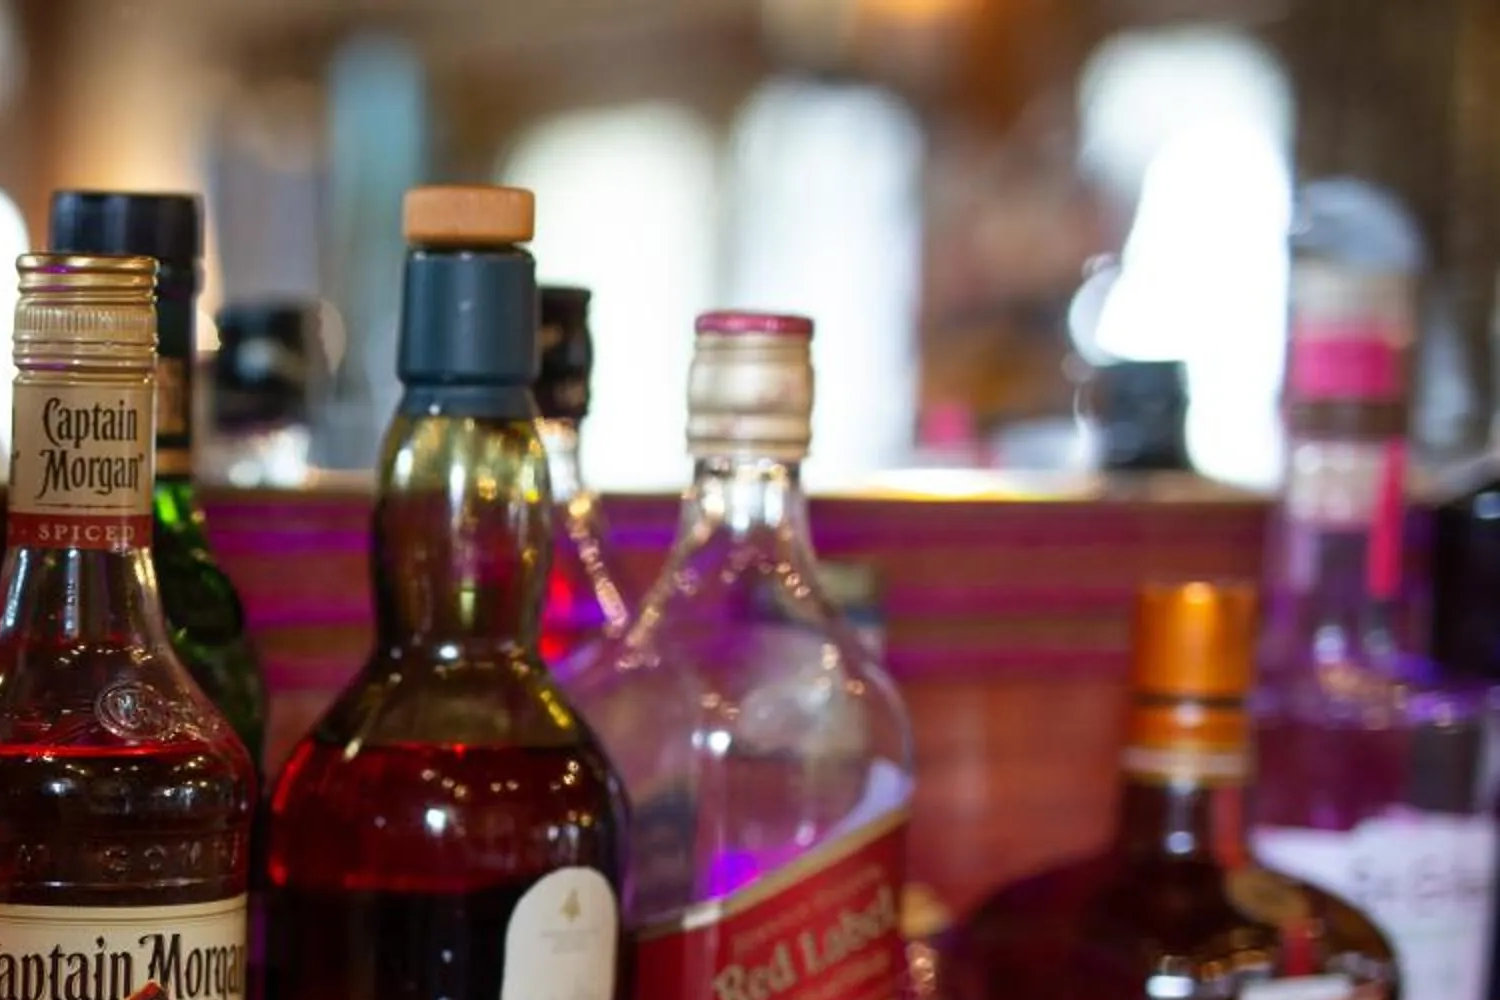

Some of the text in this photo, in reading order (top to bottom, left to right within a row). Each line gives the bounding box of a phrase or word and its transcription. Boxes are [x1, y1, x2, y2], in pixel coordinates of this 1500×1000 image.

[42, 397, 138, 449] Captain
[34, 448, 140, 499] Morgan
[38, 523, 136, 543] SPICED
[797, 884, 895, 977] Label
